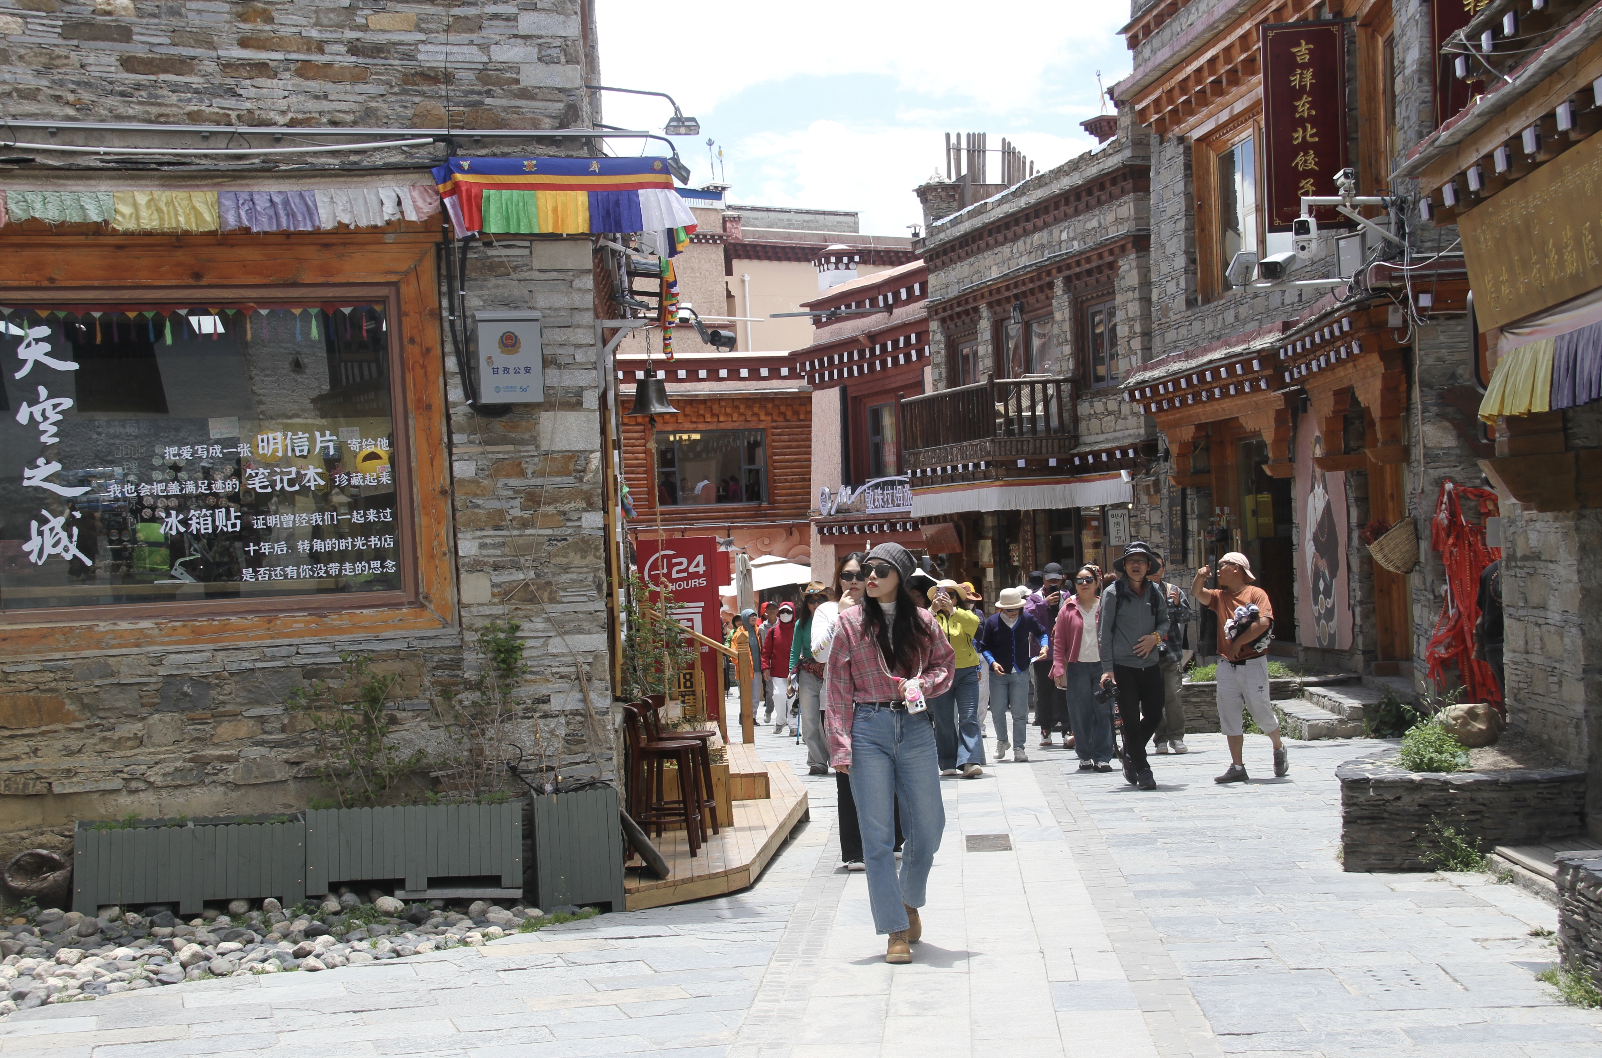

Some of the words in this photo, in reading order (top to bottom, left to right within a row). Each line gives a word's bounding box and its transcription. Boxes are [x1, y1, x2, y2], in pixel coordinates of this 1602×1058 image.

[1289, 39, 1319, 197] 吉祥东北饺子
[491, 365, 532, 375] 甘孜公安
[14, 325, 93, 567] 天空之城
[164, 443, 251, 460] 把爱写成一张
[257, 430, 337, 457] 明信片
[347, 437, 390, 452] 寄给他
[107, 479, 240, 498] 我也会把盖满足迹的
[245, 465, 326, 493] 笔记本
[334, 472, 392, 487] 珍藏起来
[159, 507, 242, 536] 冰箱贴
[251, 507, 393, 529] 证明曾经我们一起来过
[241, 559, 397, 582] 是否还有你没带走的思念
[671, 554, 706, 579] 24
[669, 577, 707, 591] HOURS
